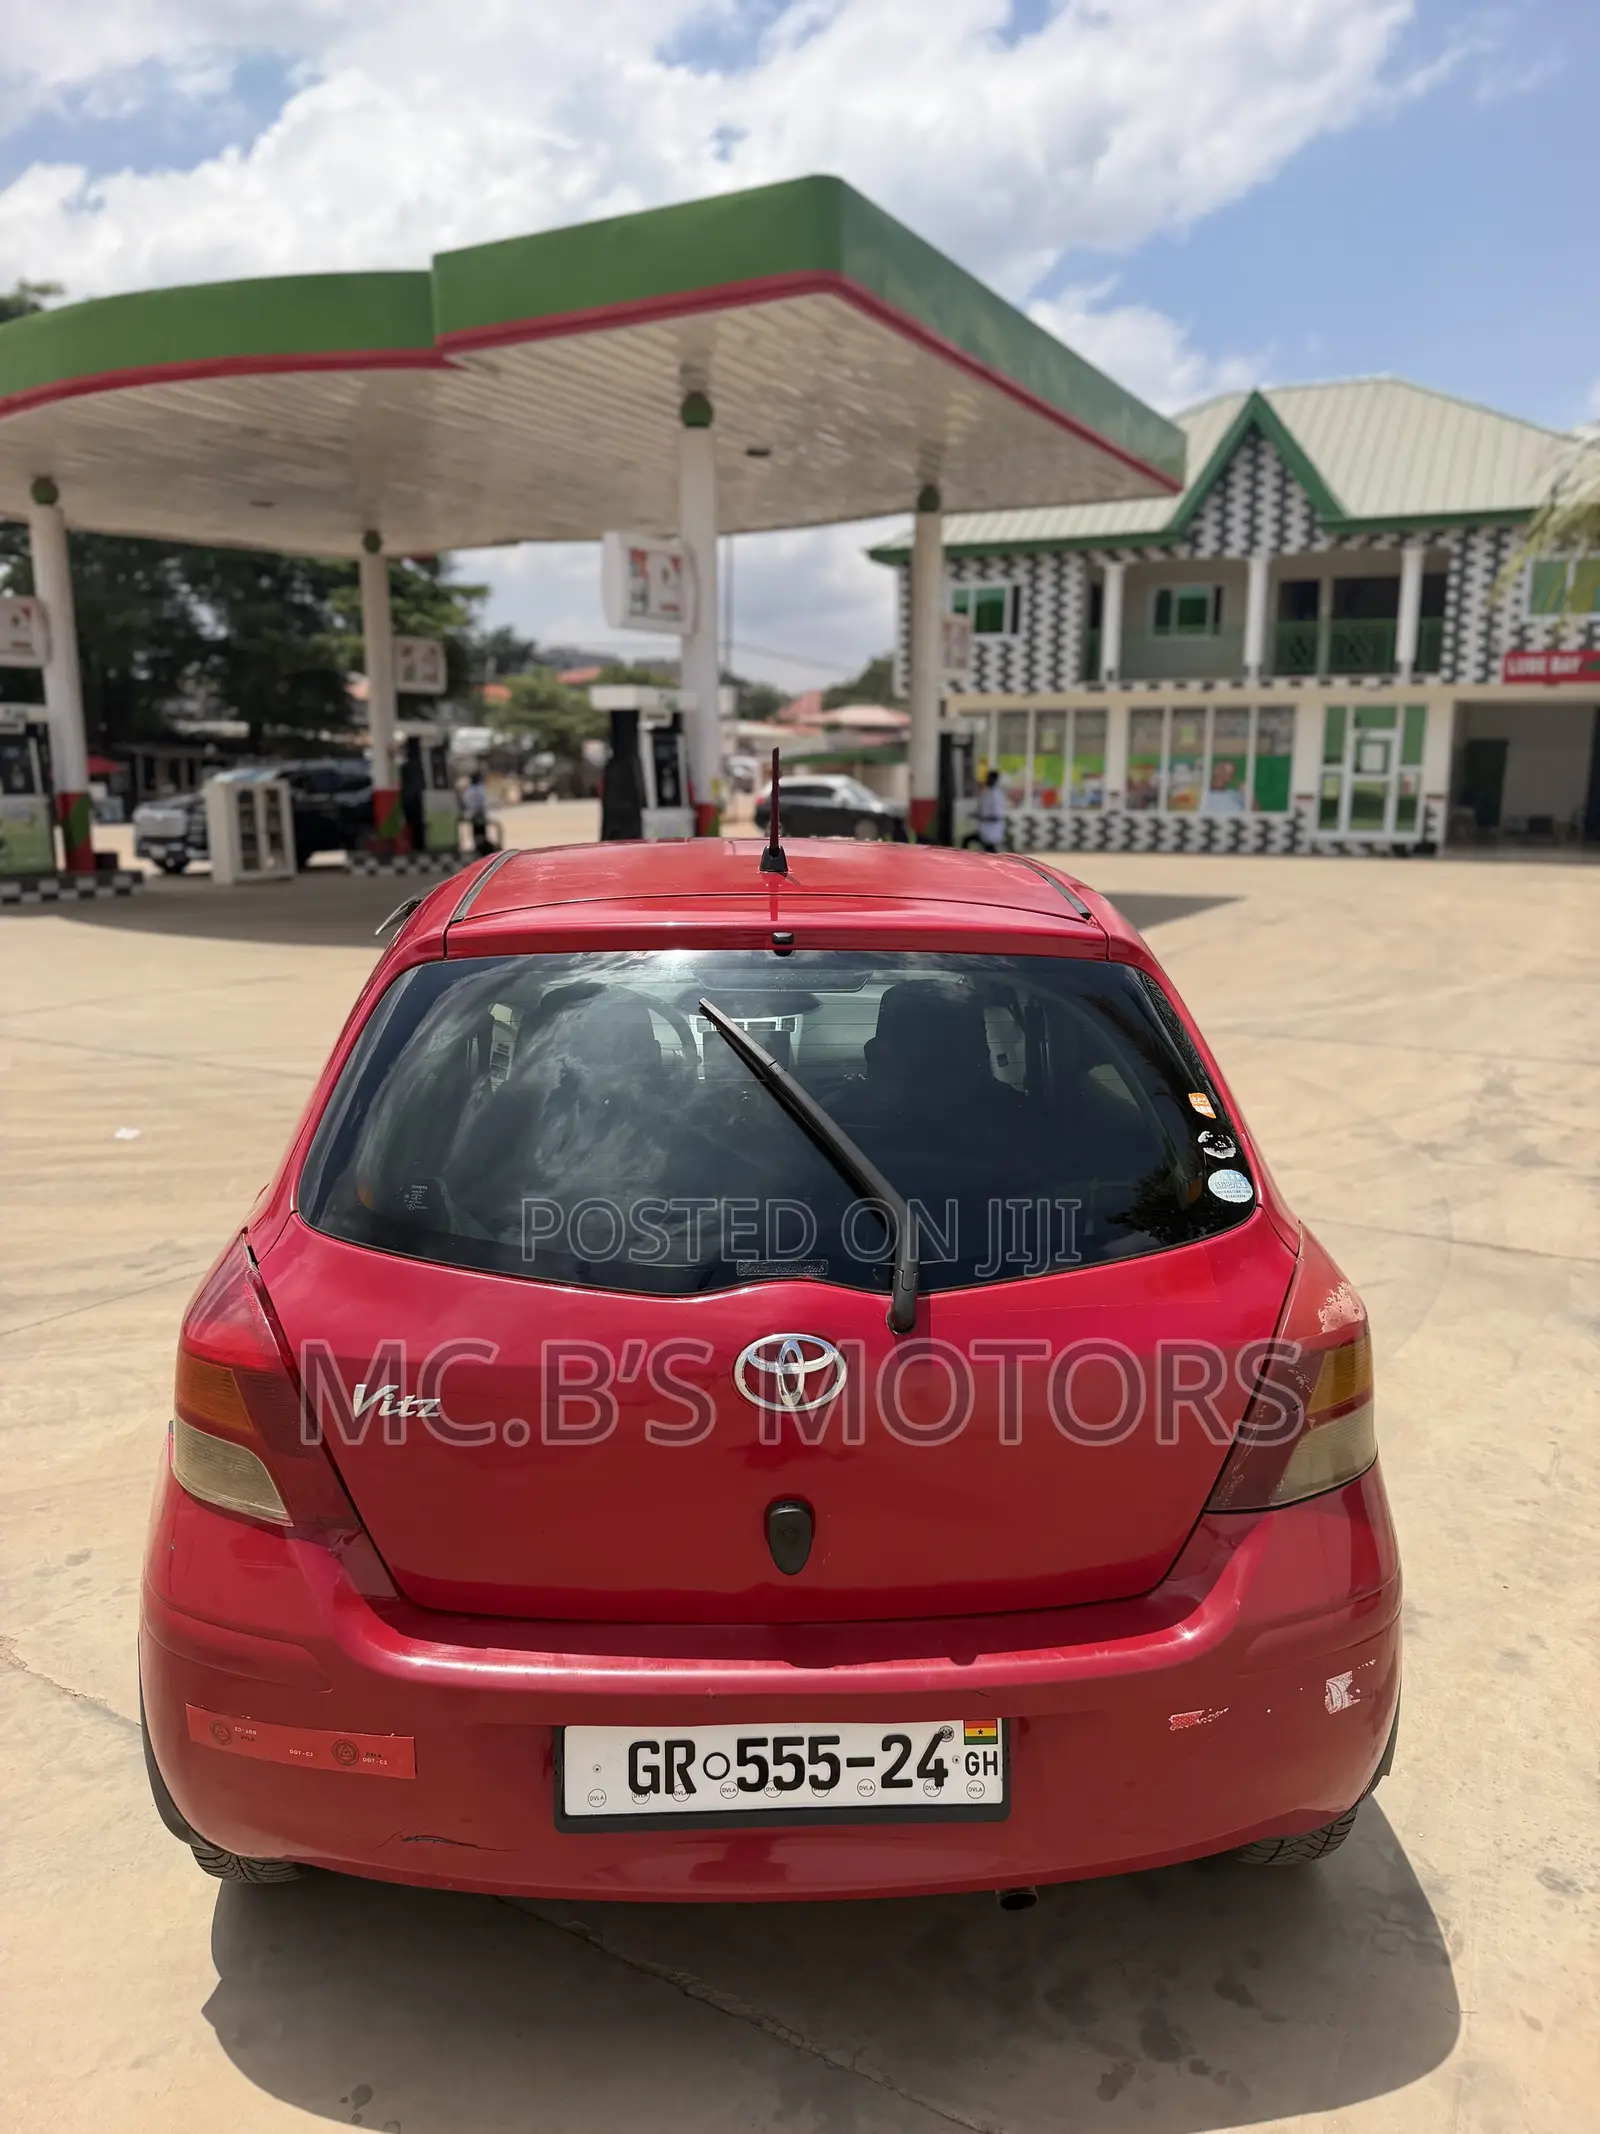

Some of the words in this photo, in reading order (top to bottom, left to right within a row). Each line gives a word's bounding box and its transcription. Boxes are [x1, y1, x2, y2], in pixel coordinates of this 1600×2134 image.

[353, 1384, 441, 1417] Vitz
[628, 1740, 697, 1794] GR
[736, 1733, 949, 1792] 555-24
[965, 1751, 998, 1776] GH
